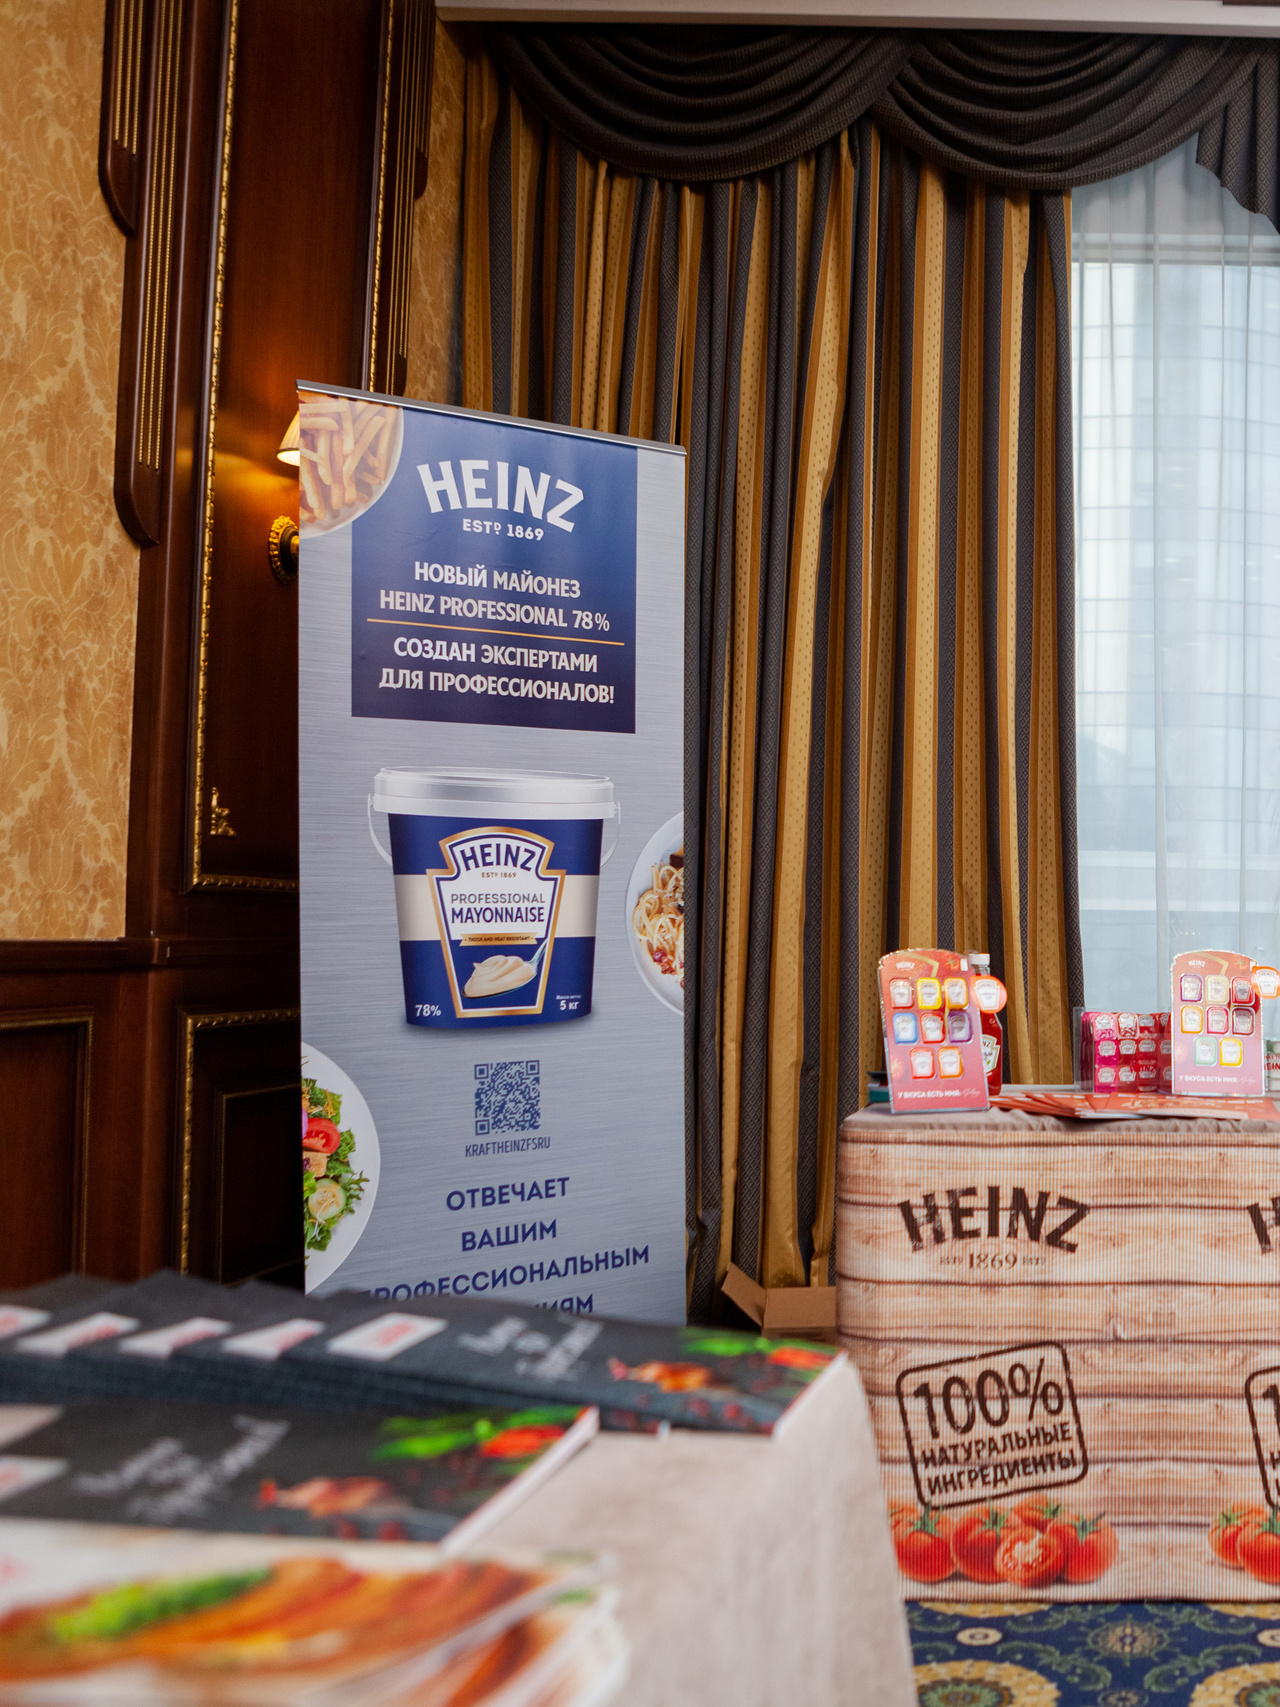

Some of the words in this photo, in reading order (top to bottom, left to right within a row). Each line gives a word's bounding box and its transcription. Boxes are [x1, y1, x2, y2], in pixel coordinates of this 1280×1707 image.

[416, 459, 584, 532] HEINZ
[506, 524, 544, 540] 1869
[414, 561, 488, 588] НОВЫЙ
[493, 569, 580, 598] МАЙОНЕЗ
[379, 590, 434, 614] HEINZ
[440, 596, 568, 628] PROFESSIONAL
[572, 610, 610, 632] 78%
[394, 636, 476, 662] СОЗДАН
[480, 644, 598, 672] ЭКСПЕРТАМИ
[379, 668, 424, 690] ДЛЯ
[429, 672, 614, 704] ПРОФЕССИОНАЛОВ!
[460, 843, 536, 872] HEINZ
[451, 893, 545, 904] PROFESSIONAL
[452, 907, 544, 924] MAYONNAISE
[415, 1004, 442, 1018] 78%
[560, 1000, 566, 1010] 5
[927, 1090, 944, 1098] ЕСТЬ
[464, 1136, 551, 1158] KRAFTHEINZFSRU
[446, 1176, 570, 1211] ОТВЕЧАЕТ
[461, 1220, 557, 1252] ВАШИМ
[897, 1186, 1090, 1254] HEINZ
[361, 1246, 649, 1300] РОФЕССИОНАЛЬНЫМ
[969, 1252, 1017, 1270] 1869
[913, 1358, 1064, 1438] 100%
[922, 1422, 1072, 1468] НАТУРАЛЬНЫЕ
[928, 1449, 1077, 1495] ИНГРЕДИЕНТЫ
